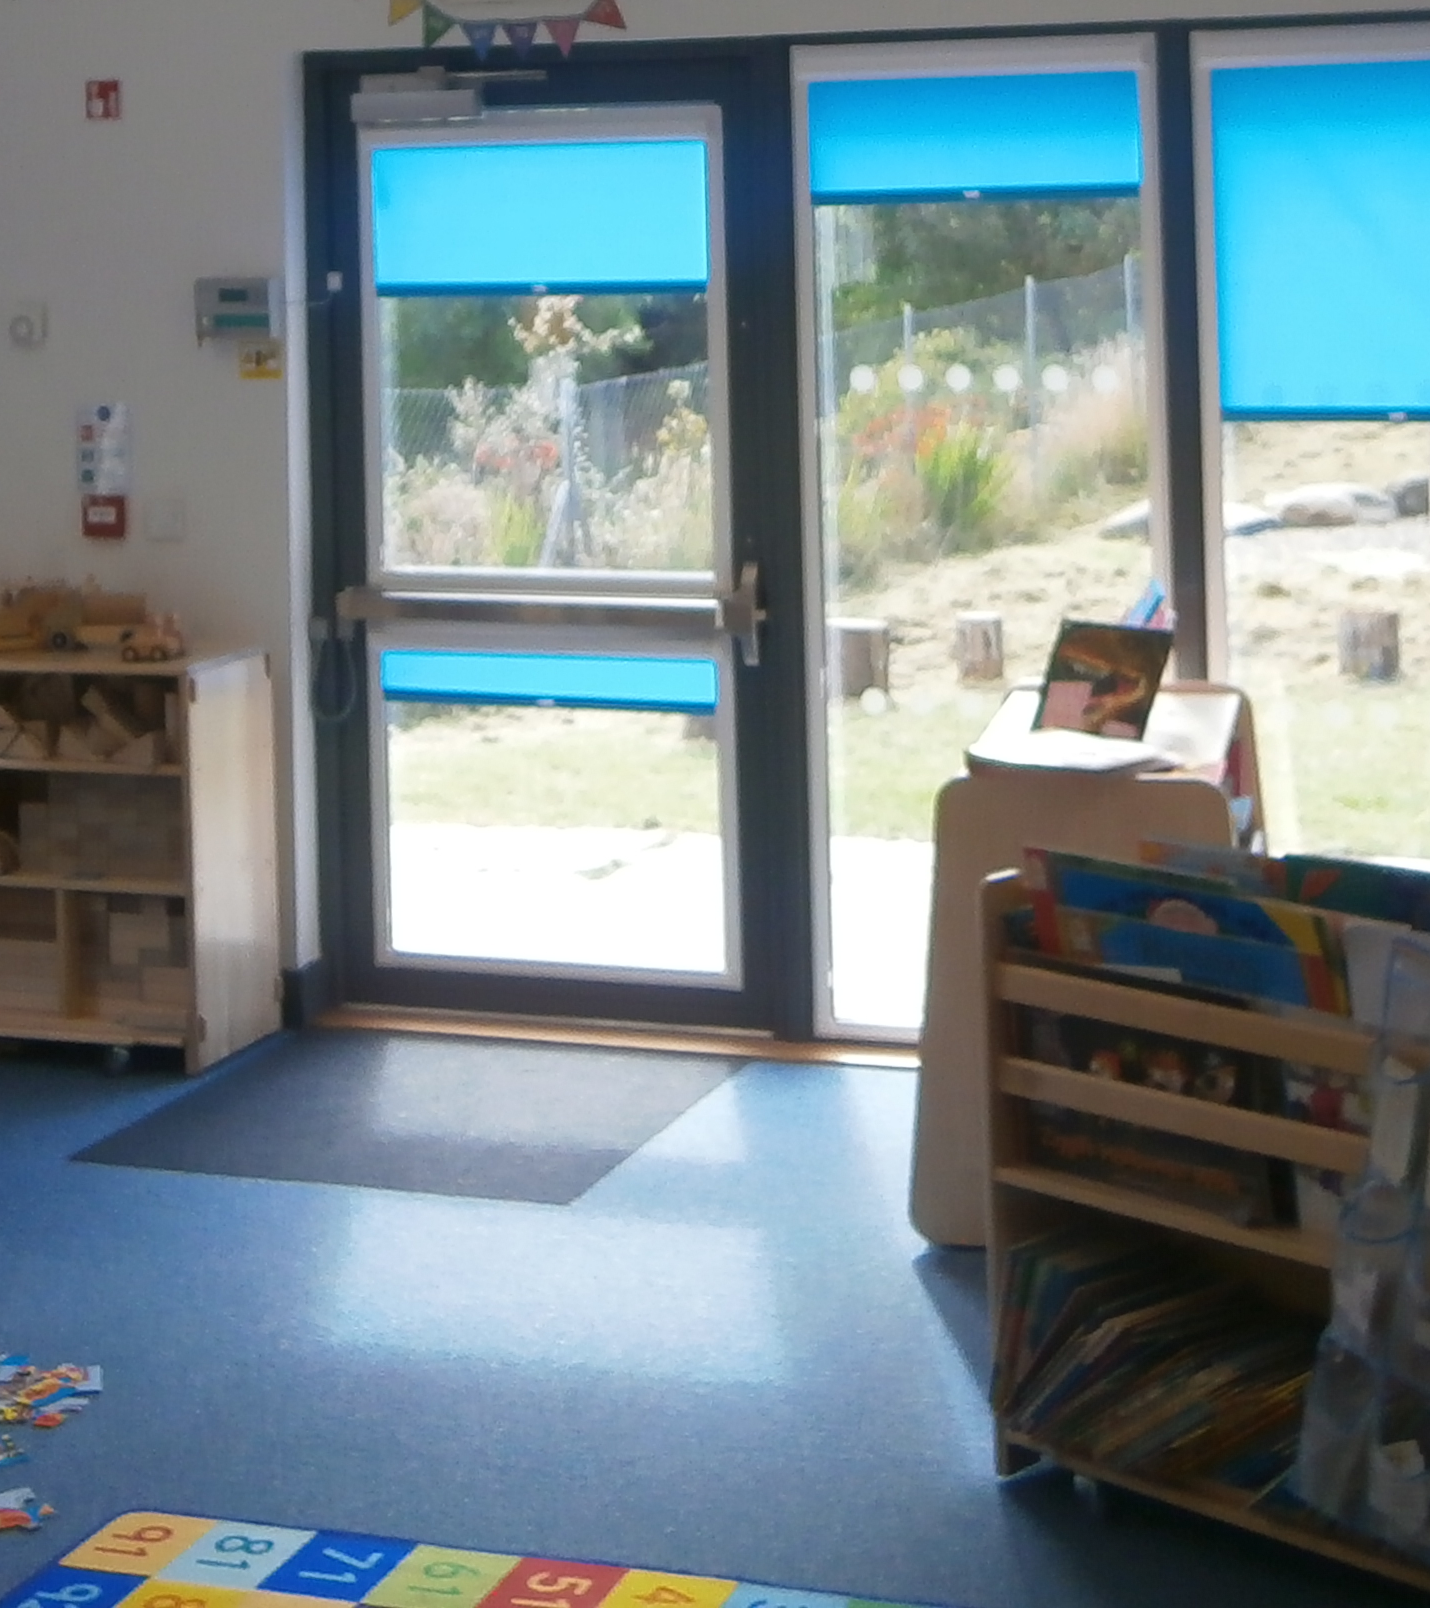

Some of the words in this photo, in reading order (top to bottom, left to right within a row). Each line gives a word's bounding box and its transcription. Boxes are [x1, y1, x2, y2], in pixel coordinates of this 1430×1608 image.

[94, 1525, 173, 1559] 91
[196, 1535, 274, 1570] 81
[299, 1546, 383, 1583] 71
[406, 1561, 480, 1597] 61
